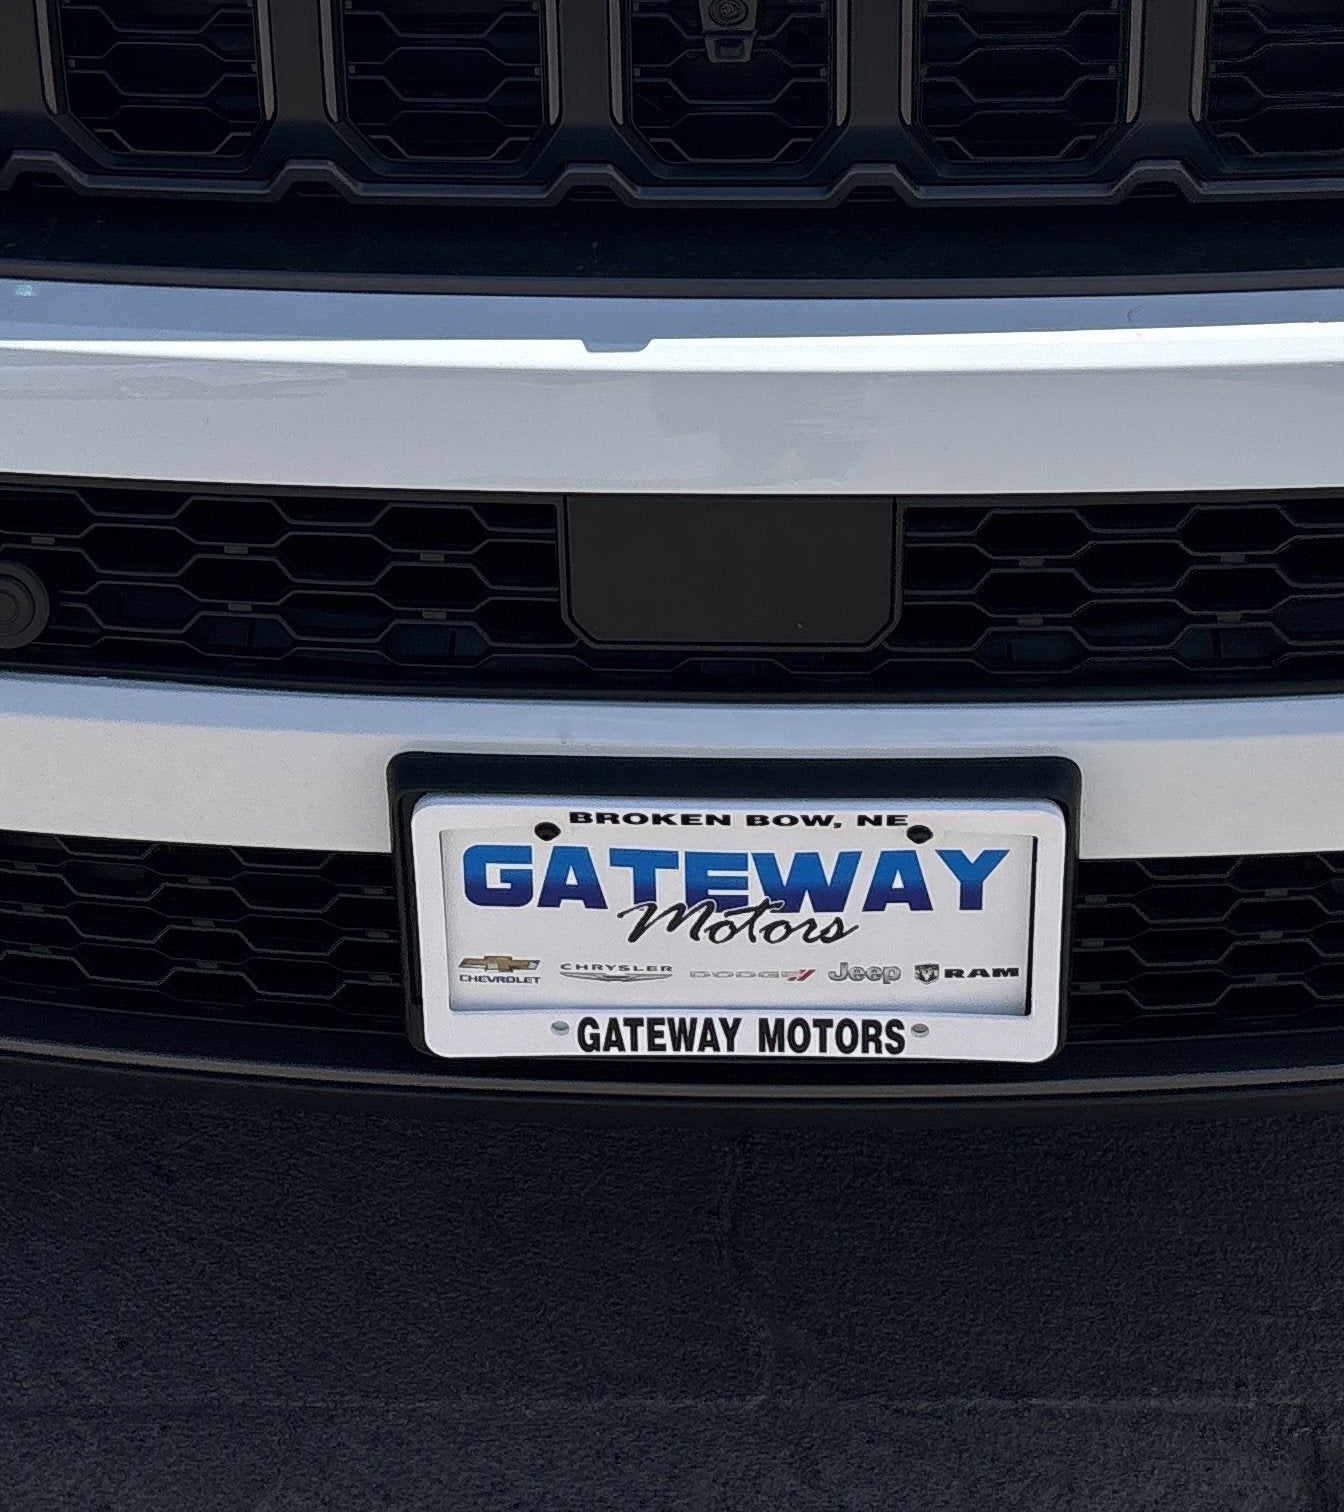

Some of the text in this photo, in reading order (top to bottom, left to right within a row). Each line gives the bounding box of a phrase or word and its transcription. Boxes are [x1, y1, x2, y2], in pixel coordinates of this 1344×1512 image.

[569, 811, 909, 830] BROKEN BOW, NE
[462, 844, 1011, 914] GATEWAY
[616, 898, 859, 945] Motors
[459, 961, 1020, 985] CHEVROLET CHRYSLER DODGE Jeep RAM
[576, 1017, 907, 1055] GATEWAY MOTORS
